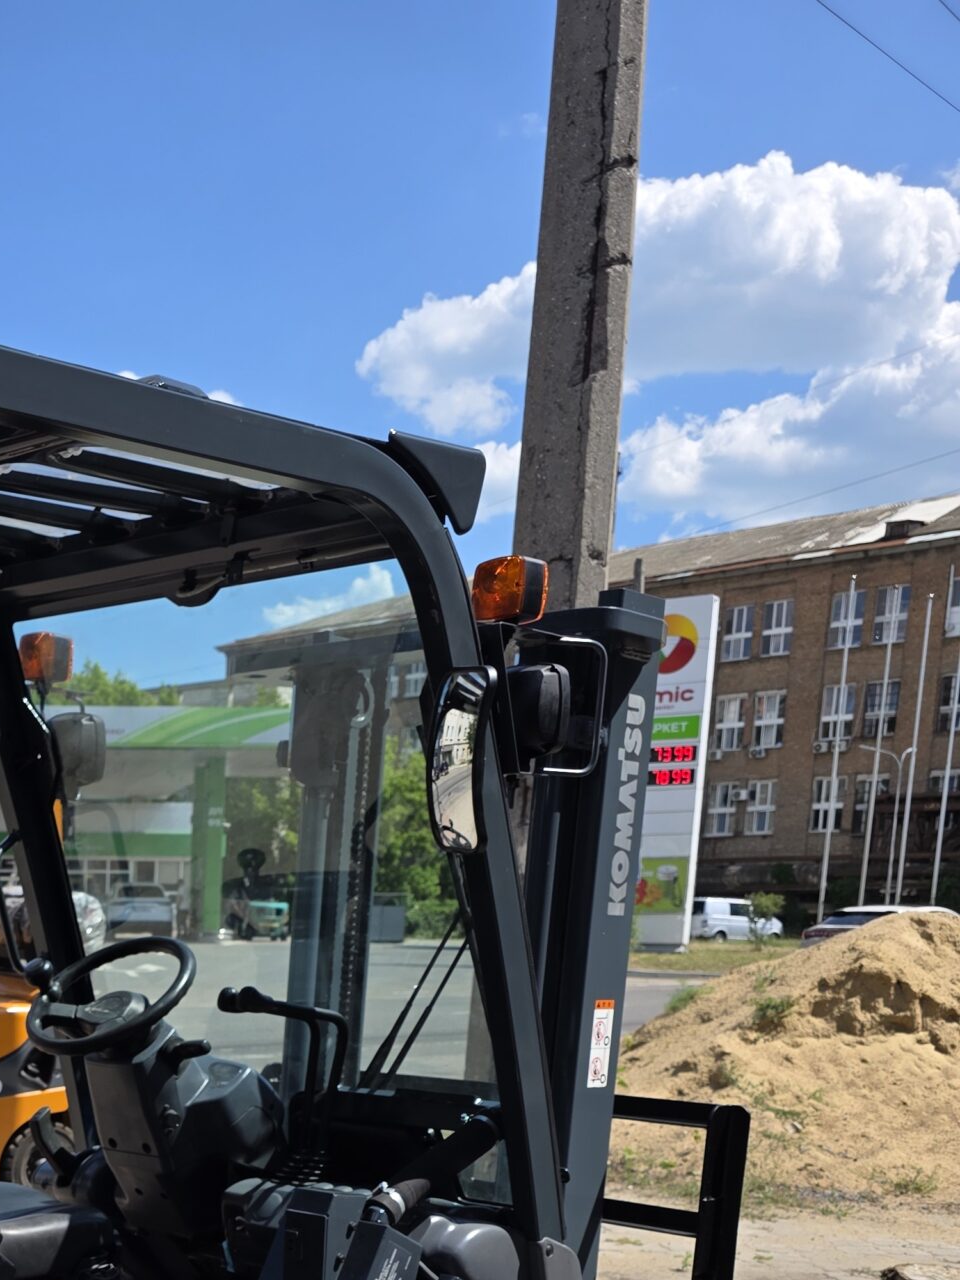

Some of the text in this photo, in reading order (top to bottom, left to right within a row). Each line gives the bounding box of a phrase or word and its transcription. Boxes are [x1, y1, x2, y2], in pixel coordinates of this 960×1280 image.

[655, 686, 694, 703] mic
[653, 721, 688, 734] РКЕТ
[607, 693, 646, 917] KOMATSU
